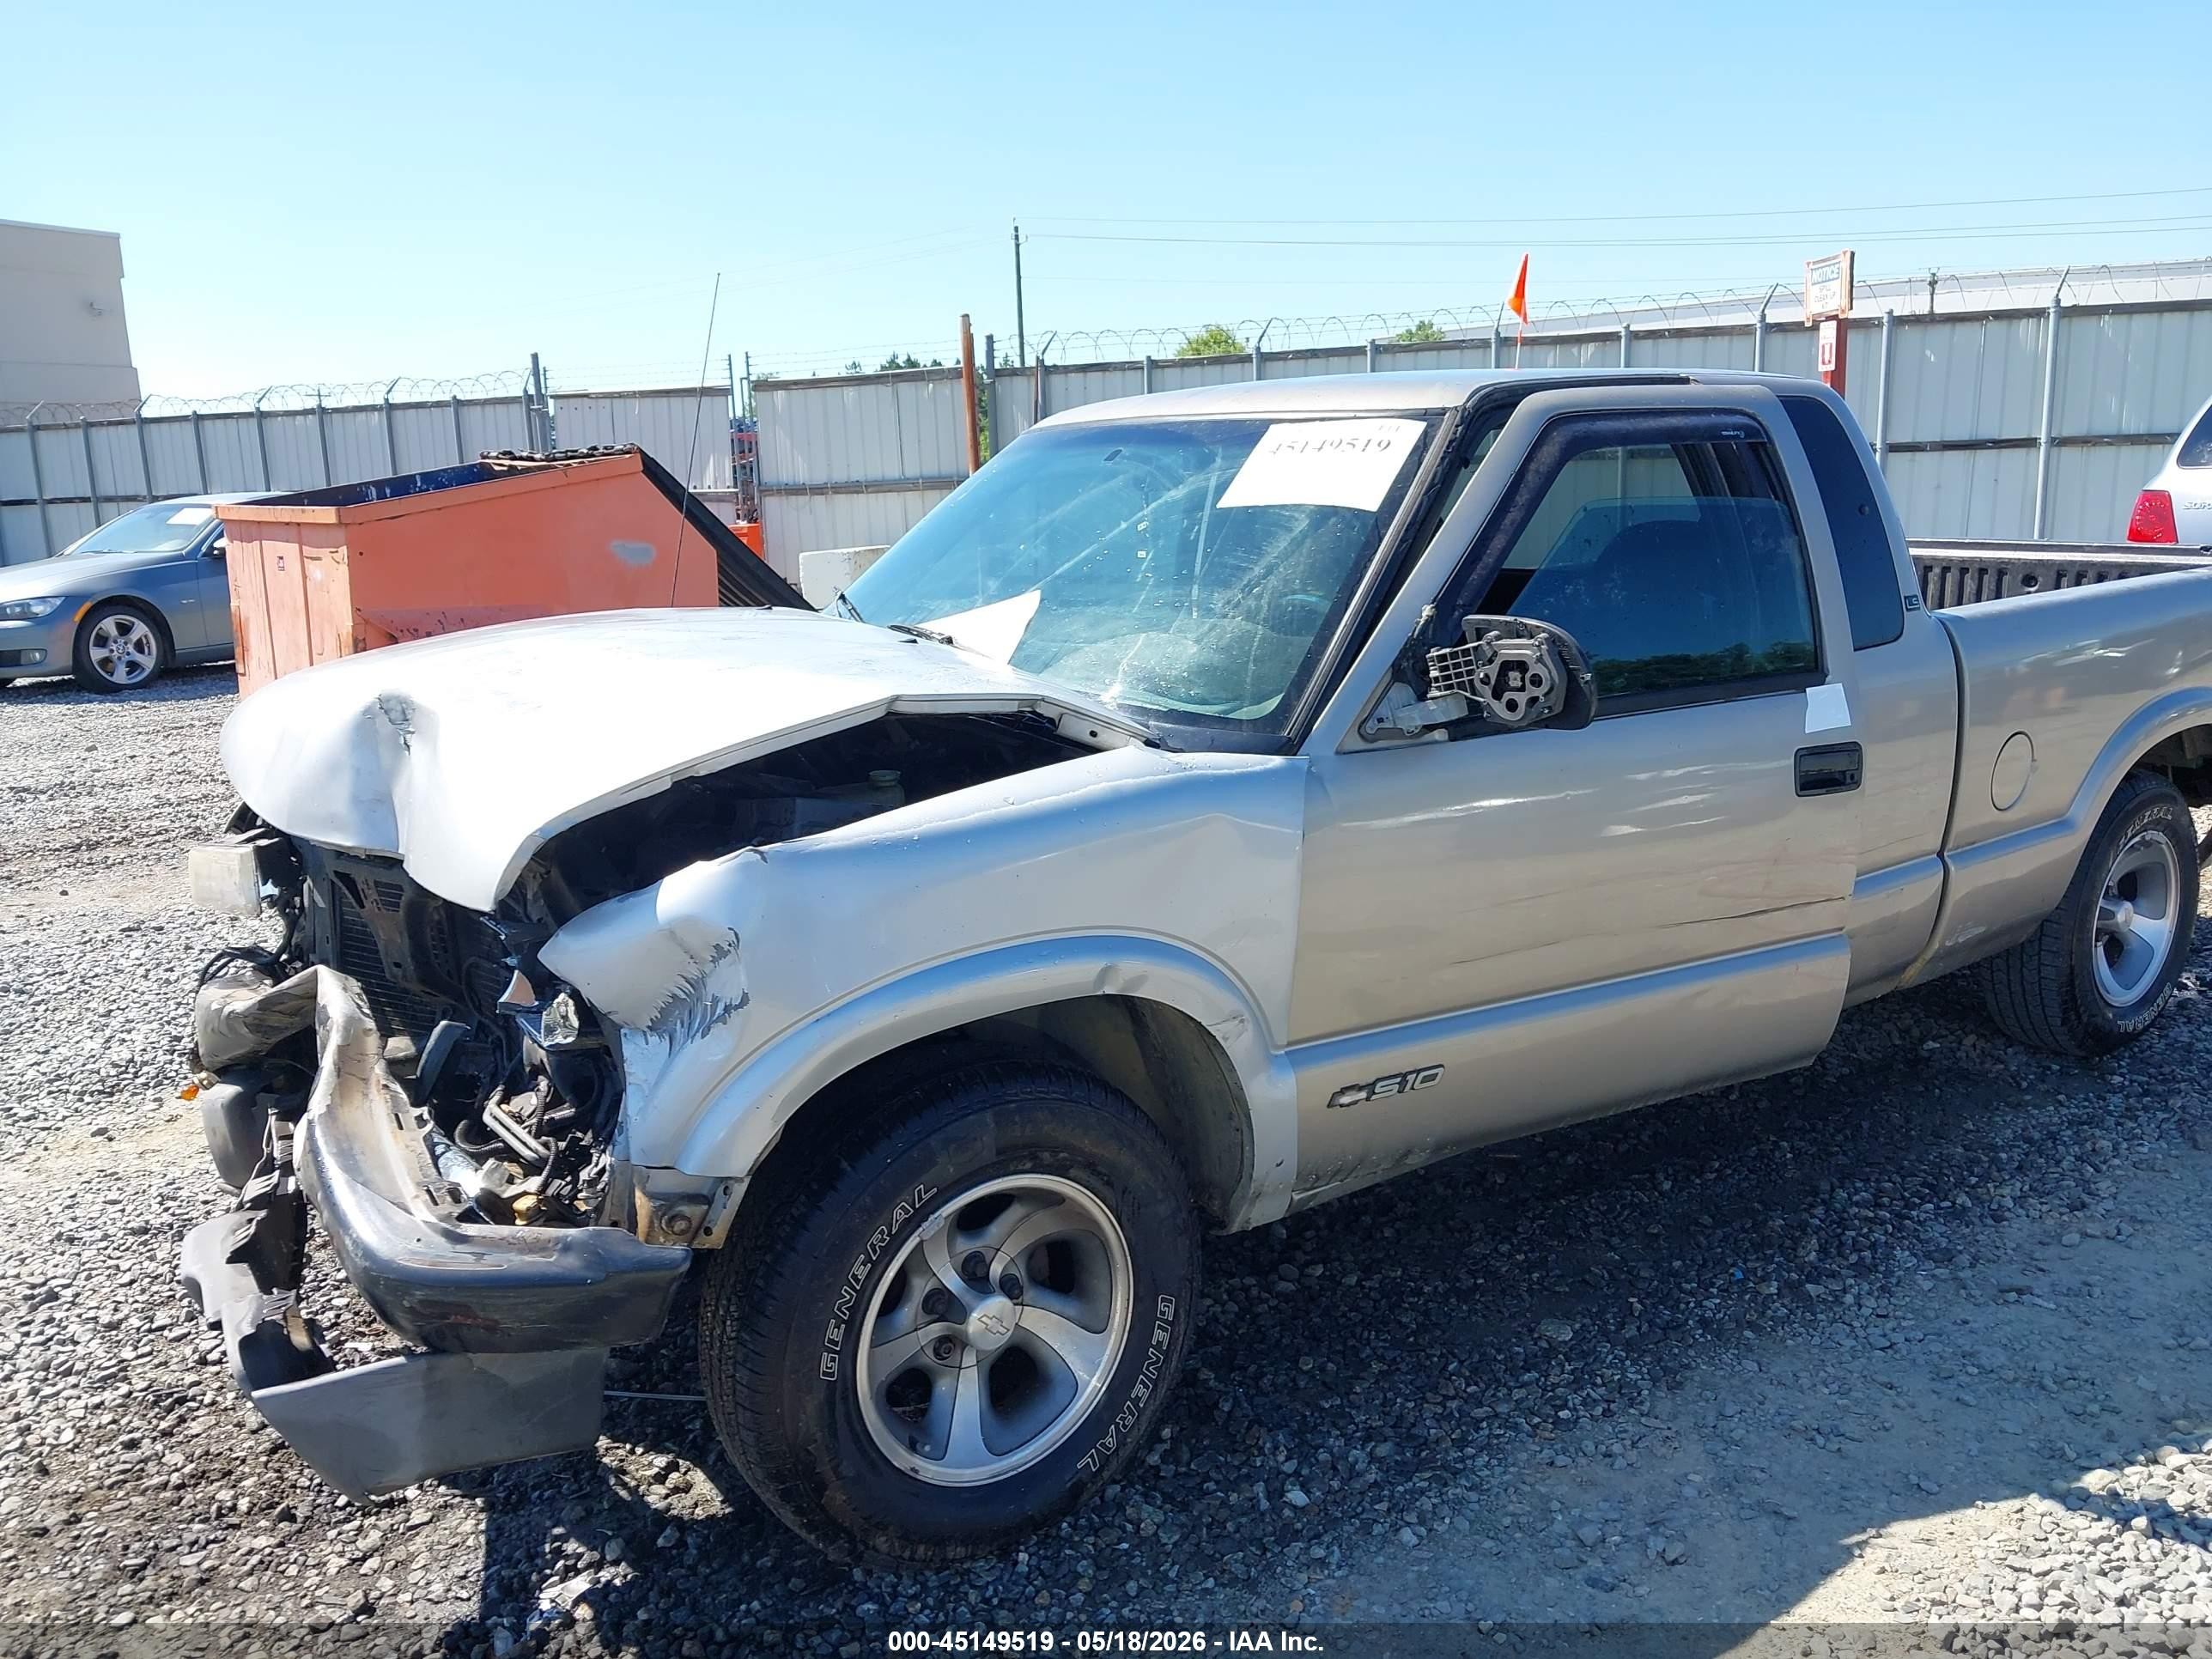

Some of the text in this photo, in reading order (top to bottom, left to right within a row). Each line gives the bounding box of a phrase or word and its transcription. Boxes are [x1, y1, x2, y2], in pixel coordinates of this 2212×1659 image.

[1811, 264, 1839, 283] NOTICE
[1370, 1065, 1445, 1101] S10
[820, 1184, 938, 1381] GENERAL
[1077, 1294, 1176, 1472] GENERAL
